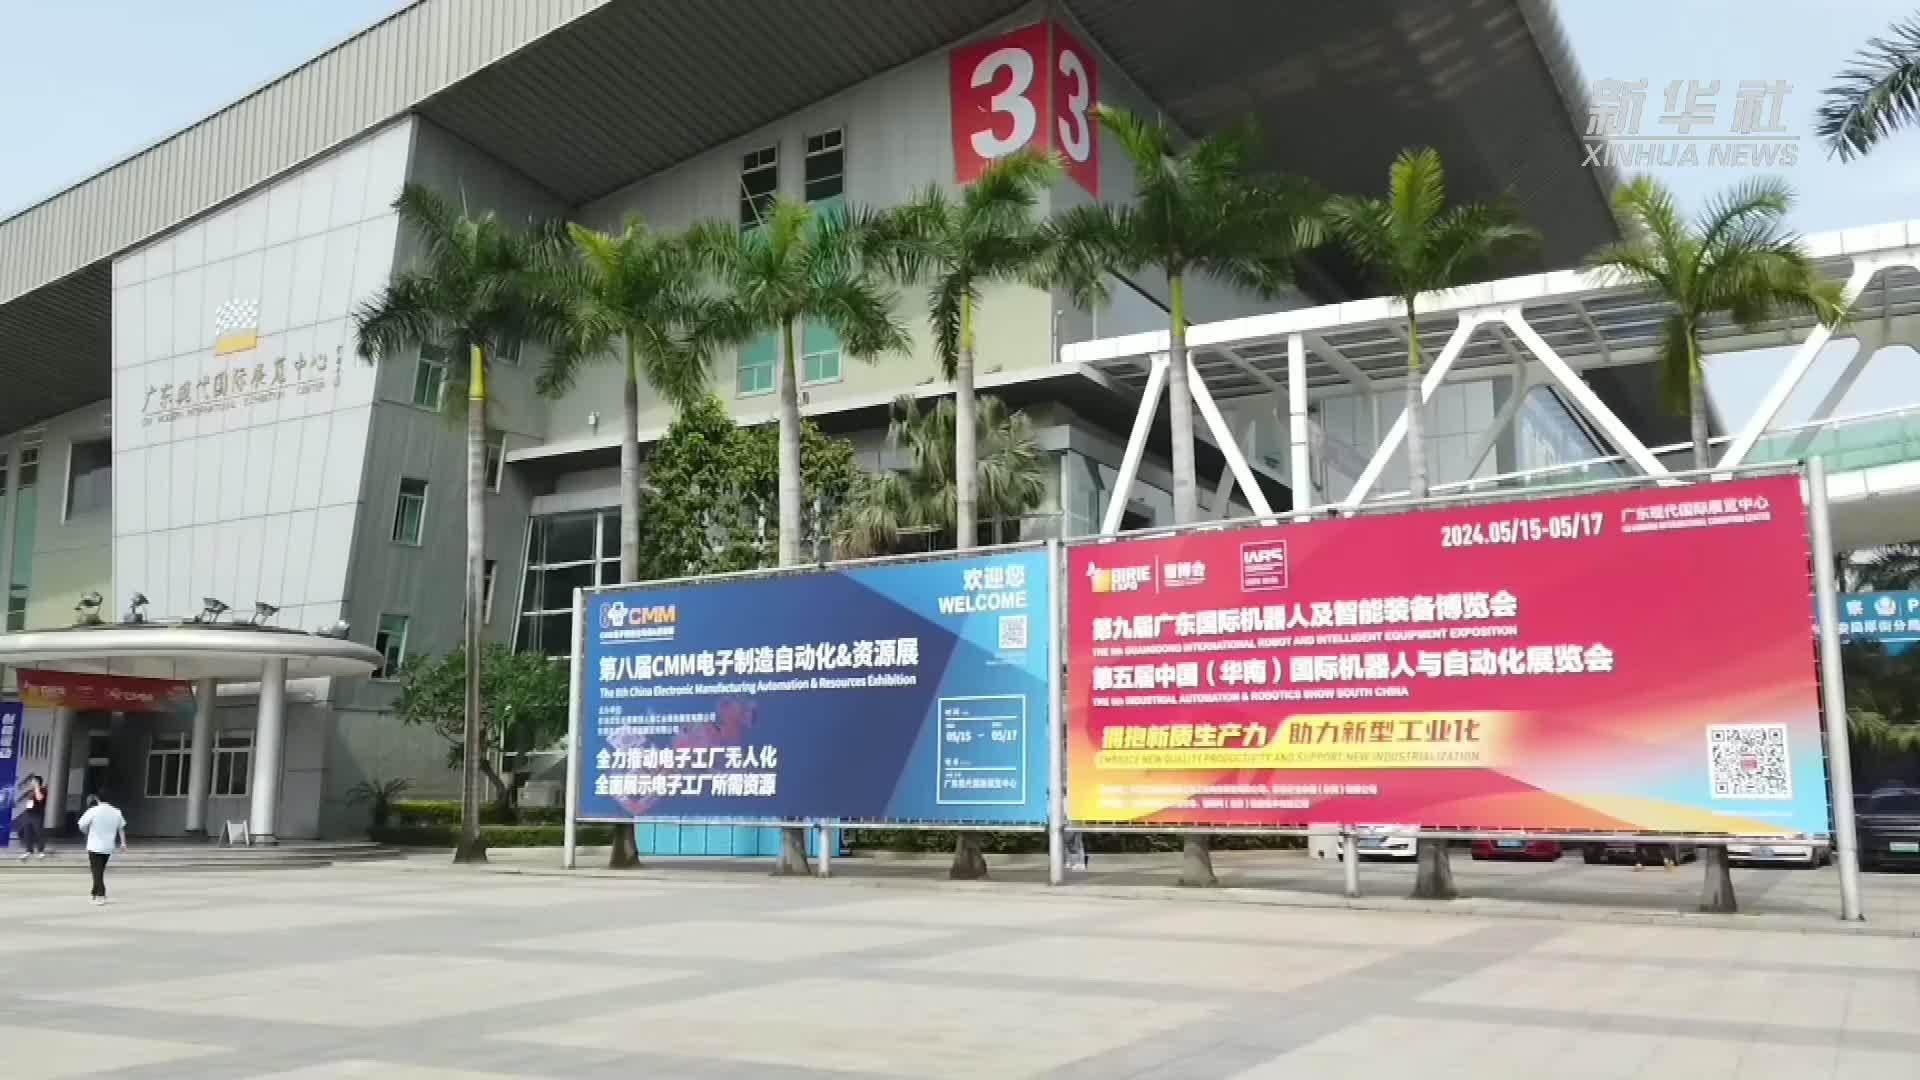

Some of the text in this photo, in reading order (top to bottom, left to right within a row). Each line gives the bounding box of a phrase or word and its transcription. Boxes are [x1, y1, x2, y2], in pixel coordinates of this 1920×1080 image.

[969, 48, 1036, 159] 3
[1058, 50, 1090, 162] 3
[1441, 512, 1603, 547] 2024.05/15-05/17
[963, 564, 1025, 591] 欢迎您
[628, 605, 676, 625] CMM
[938, 592, 1027, 615] WELCOME
[1092, 590, 1518, 641] 第九届广东国际机器人及智能装备博览会
[1449, 625, 1518, 638] EXPOSITION
[599, 637, 919, 681] 第八届CMM电子制造自动化&资源展
[630, 685, 652, 697] China
[654, 683, 693, 696] Electronic
[695, 680, 756, 695] Manufacturing
[757, 677, 809, 692] Automation
[810, 678, 818, 689] &
[819, 676, 866, 689] Resources
[867, 674, 917, 687] Exhibition
[1102, 718, 1481, 749] 拥抱新质生产力 助力新型工业化
[596, 746, 777, 769] 全力推动电子工厂无人化
[1346, 751, 1370, 762] NEW
[1374, 750, 1480, 762] INDUSTRIALIZATION
[595, 772, 777, 796] 全面展示电子工厂所需资源
